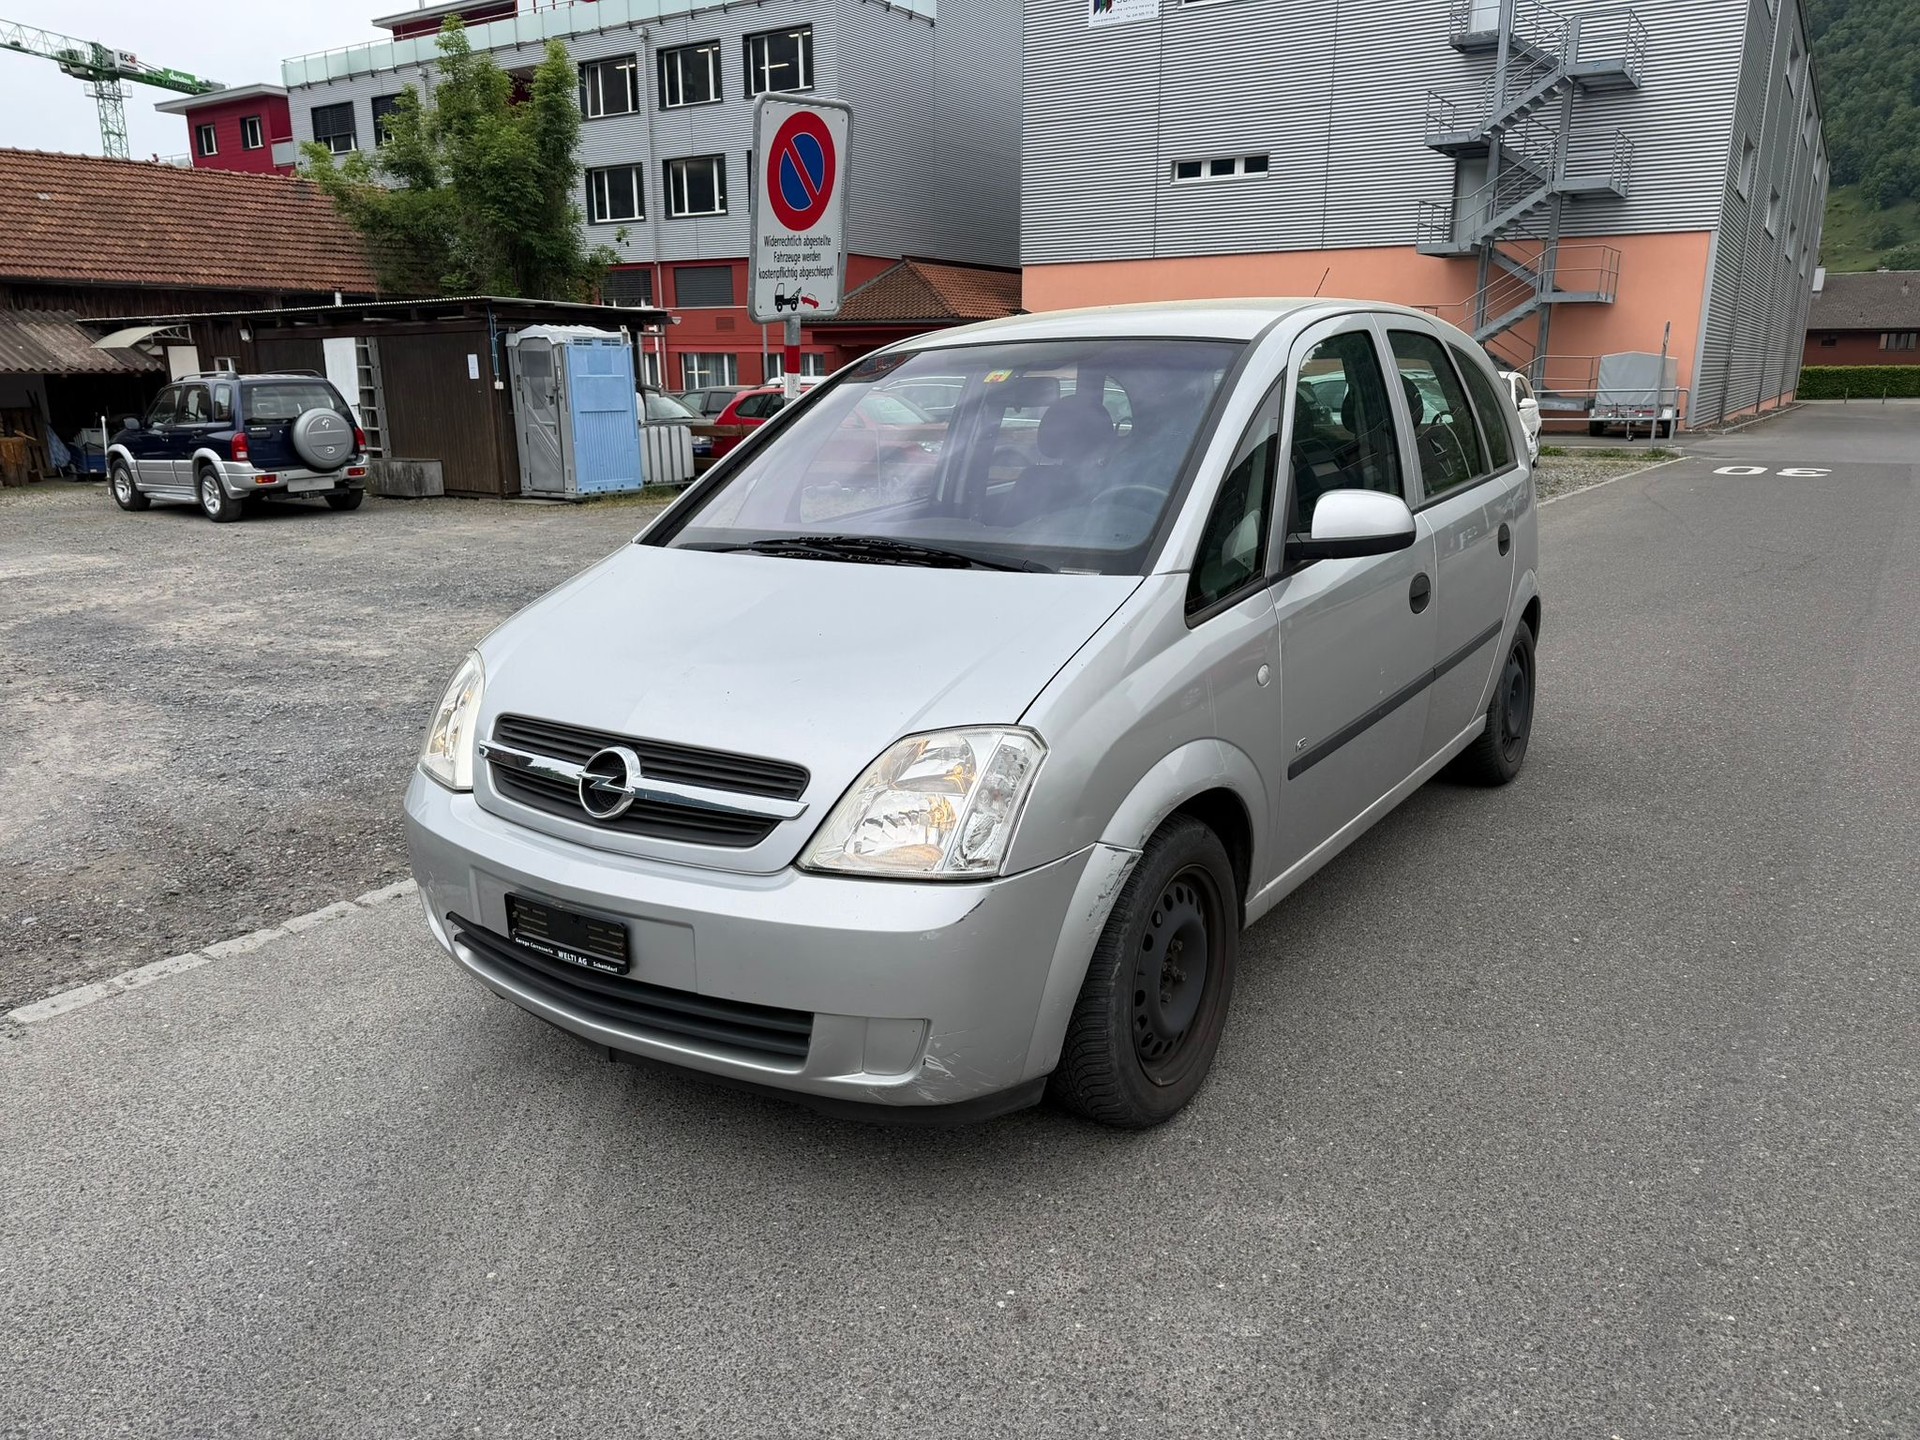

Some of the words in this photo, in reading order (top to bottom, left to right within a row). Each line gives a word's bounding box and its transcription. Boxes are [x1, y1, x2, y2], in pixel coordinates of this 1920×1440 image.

[763, 234, 802, 247] Widerrechtlich
[803, 234, 832, 249] abgestellte
[773, 250, 801, 265] Fahrzeuge
[801, 249, 821, 262] werden
[758, 265, 798, 281] kostenpflichtig
[557, 950, 577, 962] WELTI
[577, 956, 588, 966] AG
